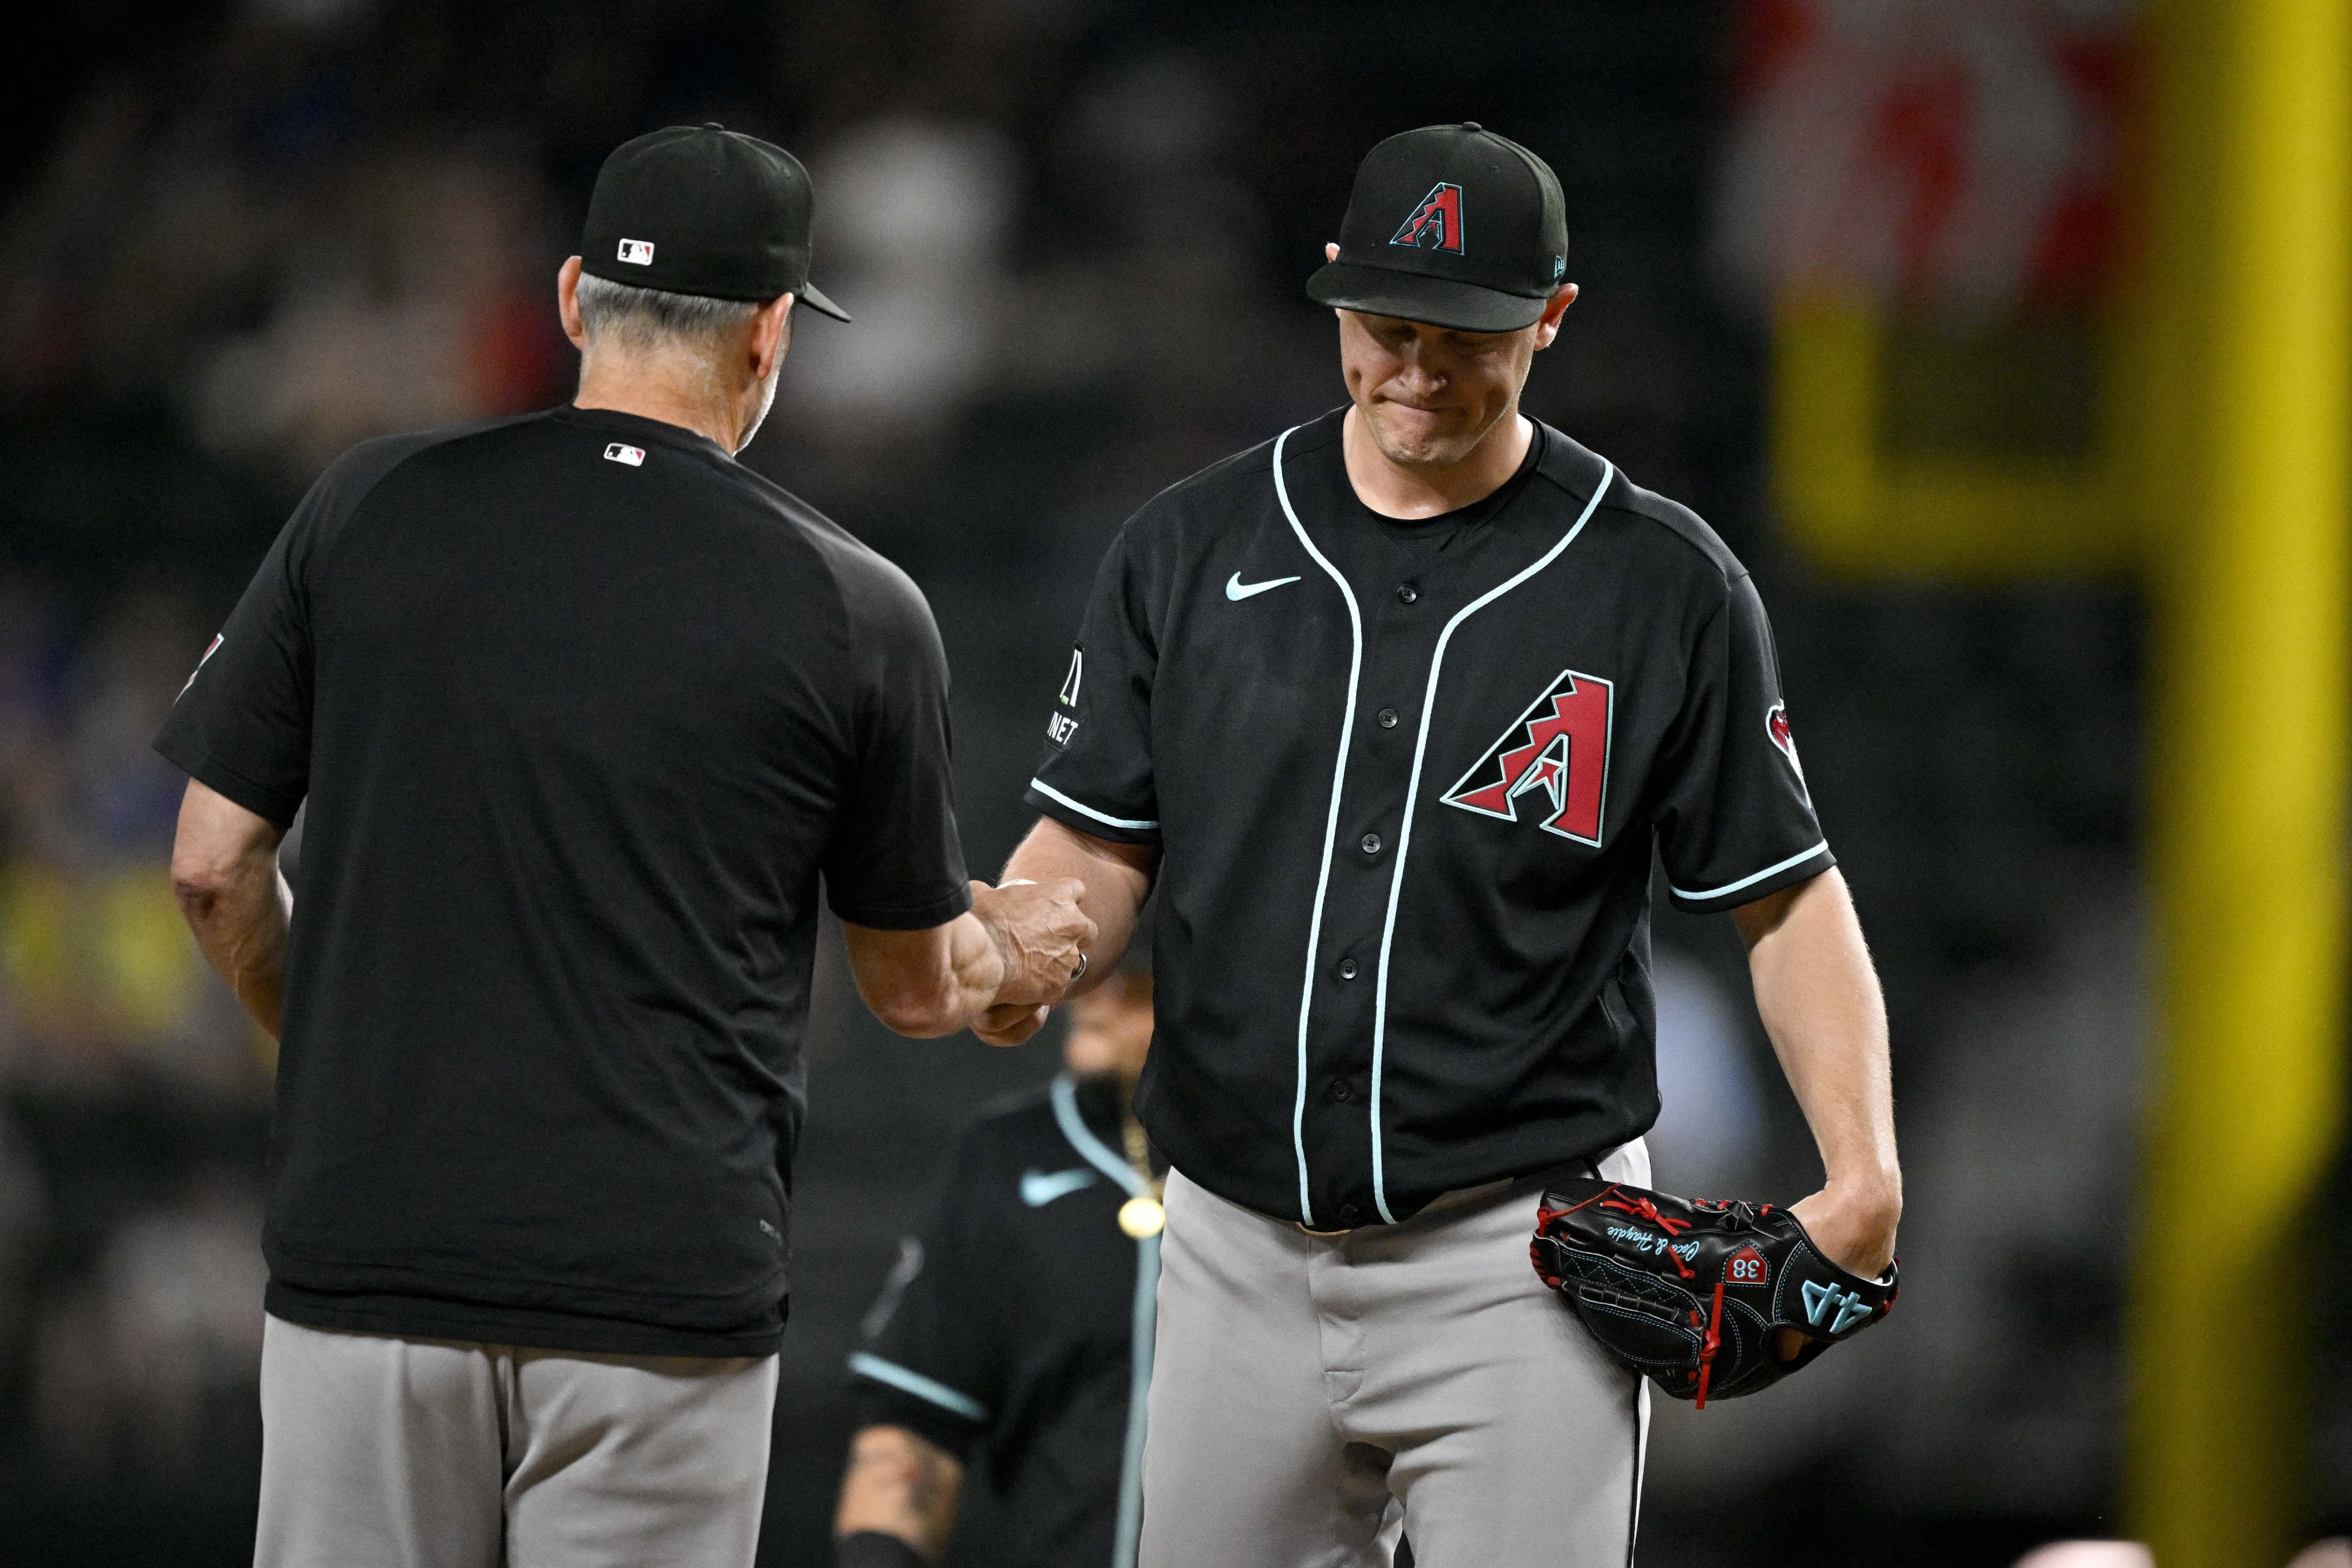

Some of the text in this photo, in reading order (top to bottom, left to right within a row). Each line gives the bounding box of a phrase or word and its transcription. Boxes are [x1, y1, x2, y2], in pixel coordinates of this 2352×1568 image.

[1047, 710, 1079, 745] NET
[1656, 1238, 1668, 1255] &
[1733, 1259, 1758, 1279] 38
[1801, 1280, 1872, 1334] 44
